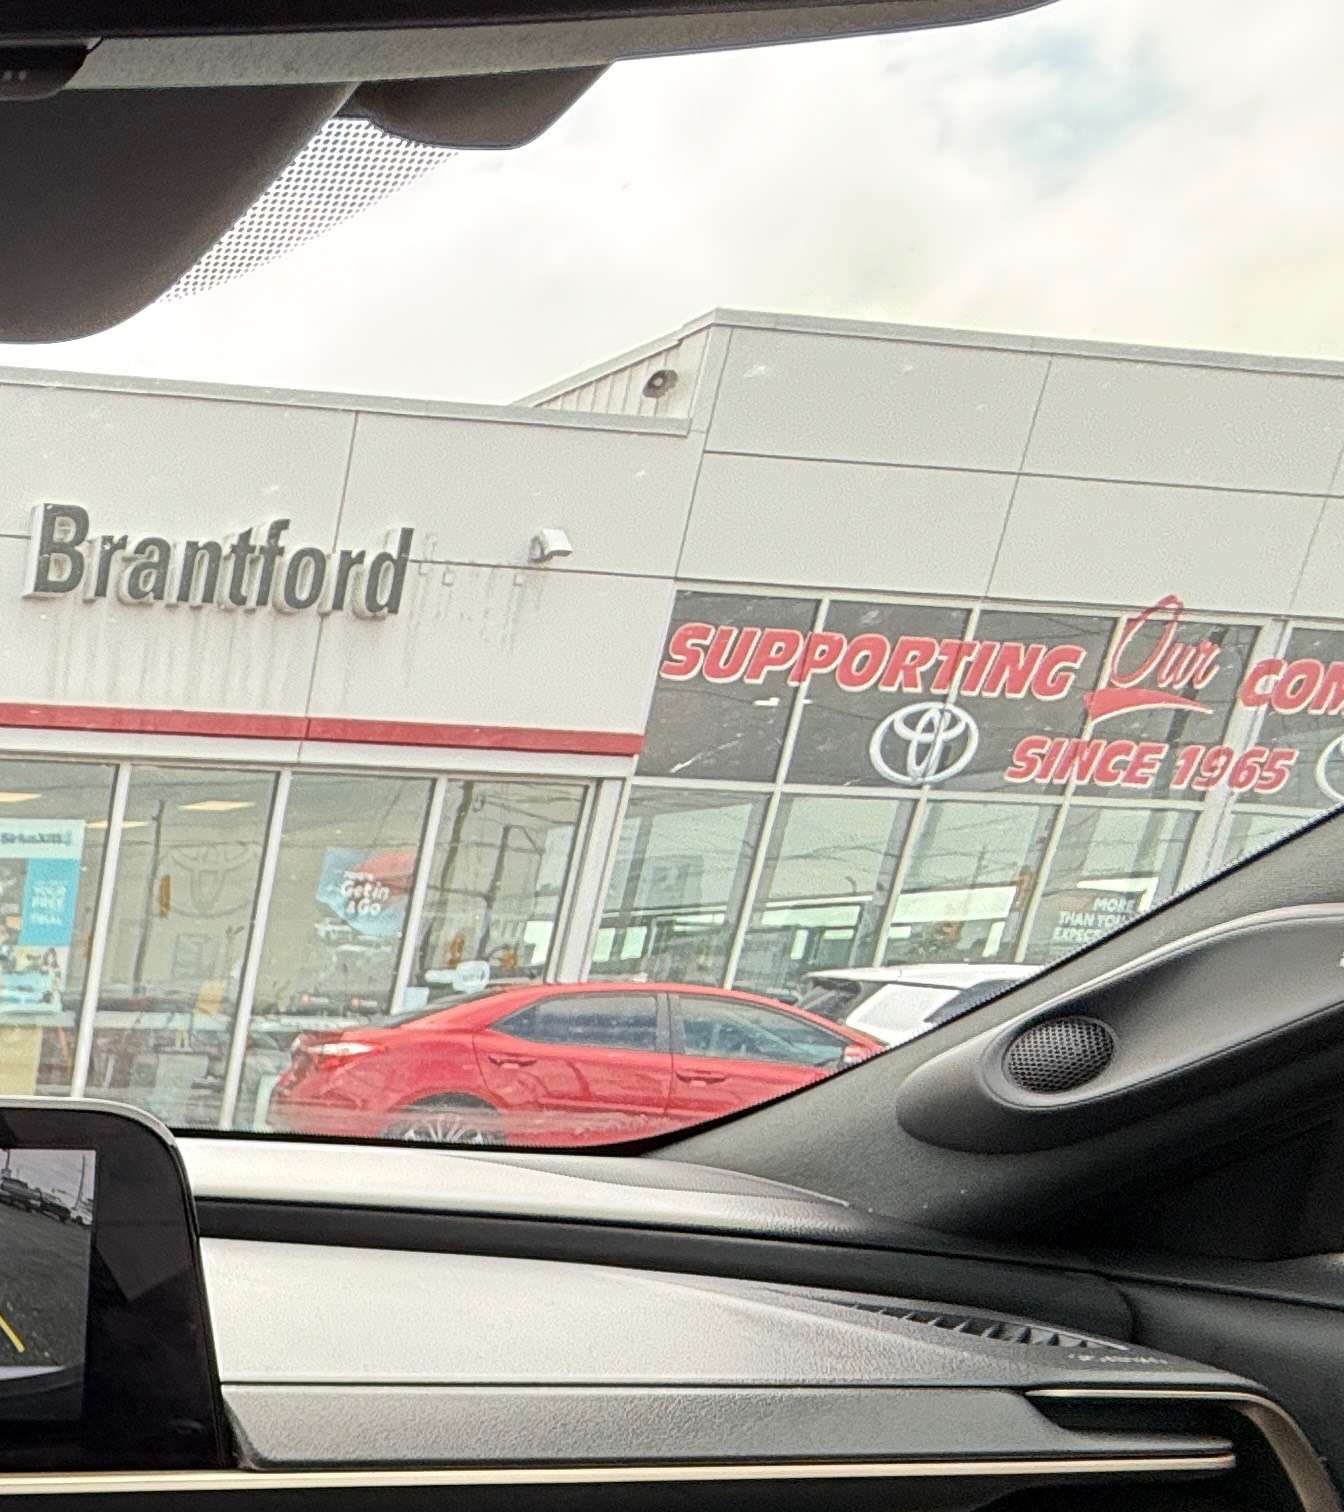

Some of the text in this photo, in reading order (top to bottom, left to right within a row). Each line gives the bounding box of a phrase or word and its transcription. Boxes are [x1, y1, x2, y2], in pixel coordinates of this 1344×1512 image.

[26, 501, 416, 617] Brantford
[660, 623, 1086, 700] SUPPORTING
[1109, 595, 1220, 690] Our
[1004, 736, 1298, 794] SINCE 1965
